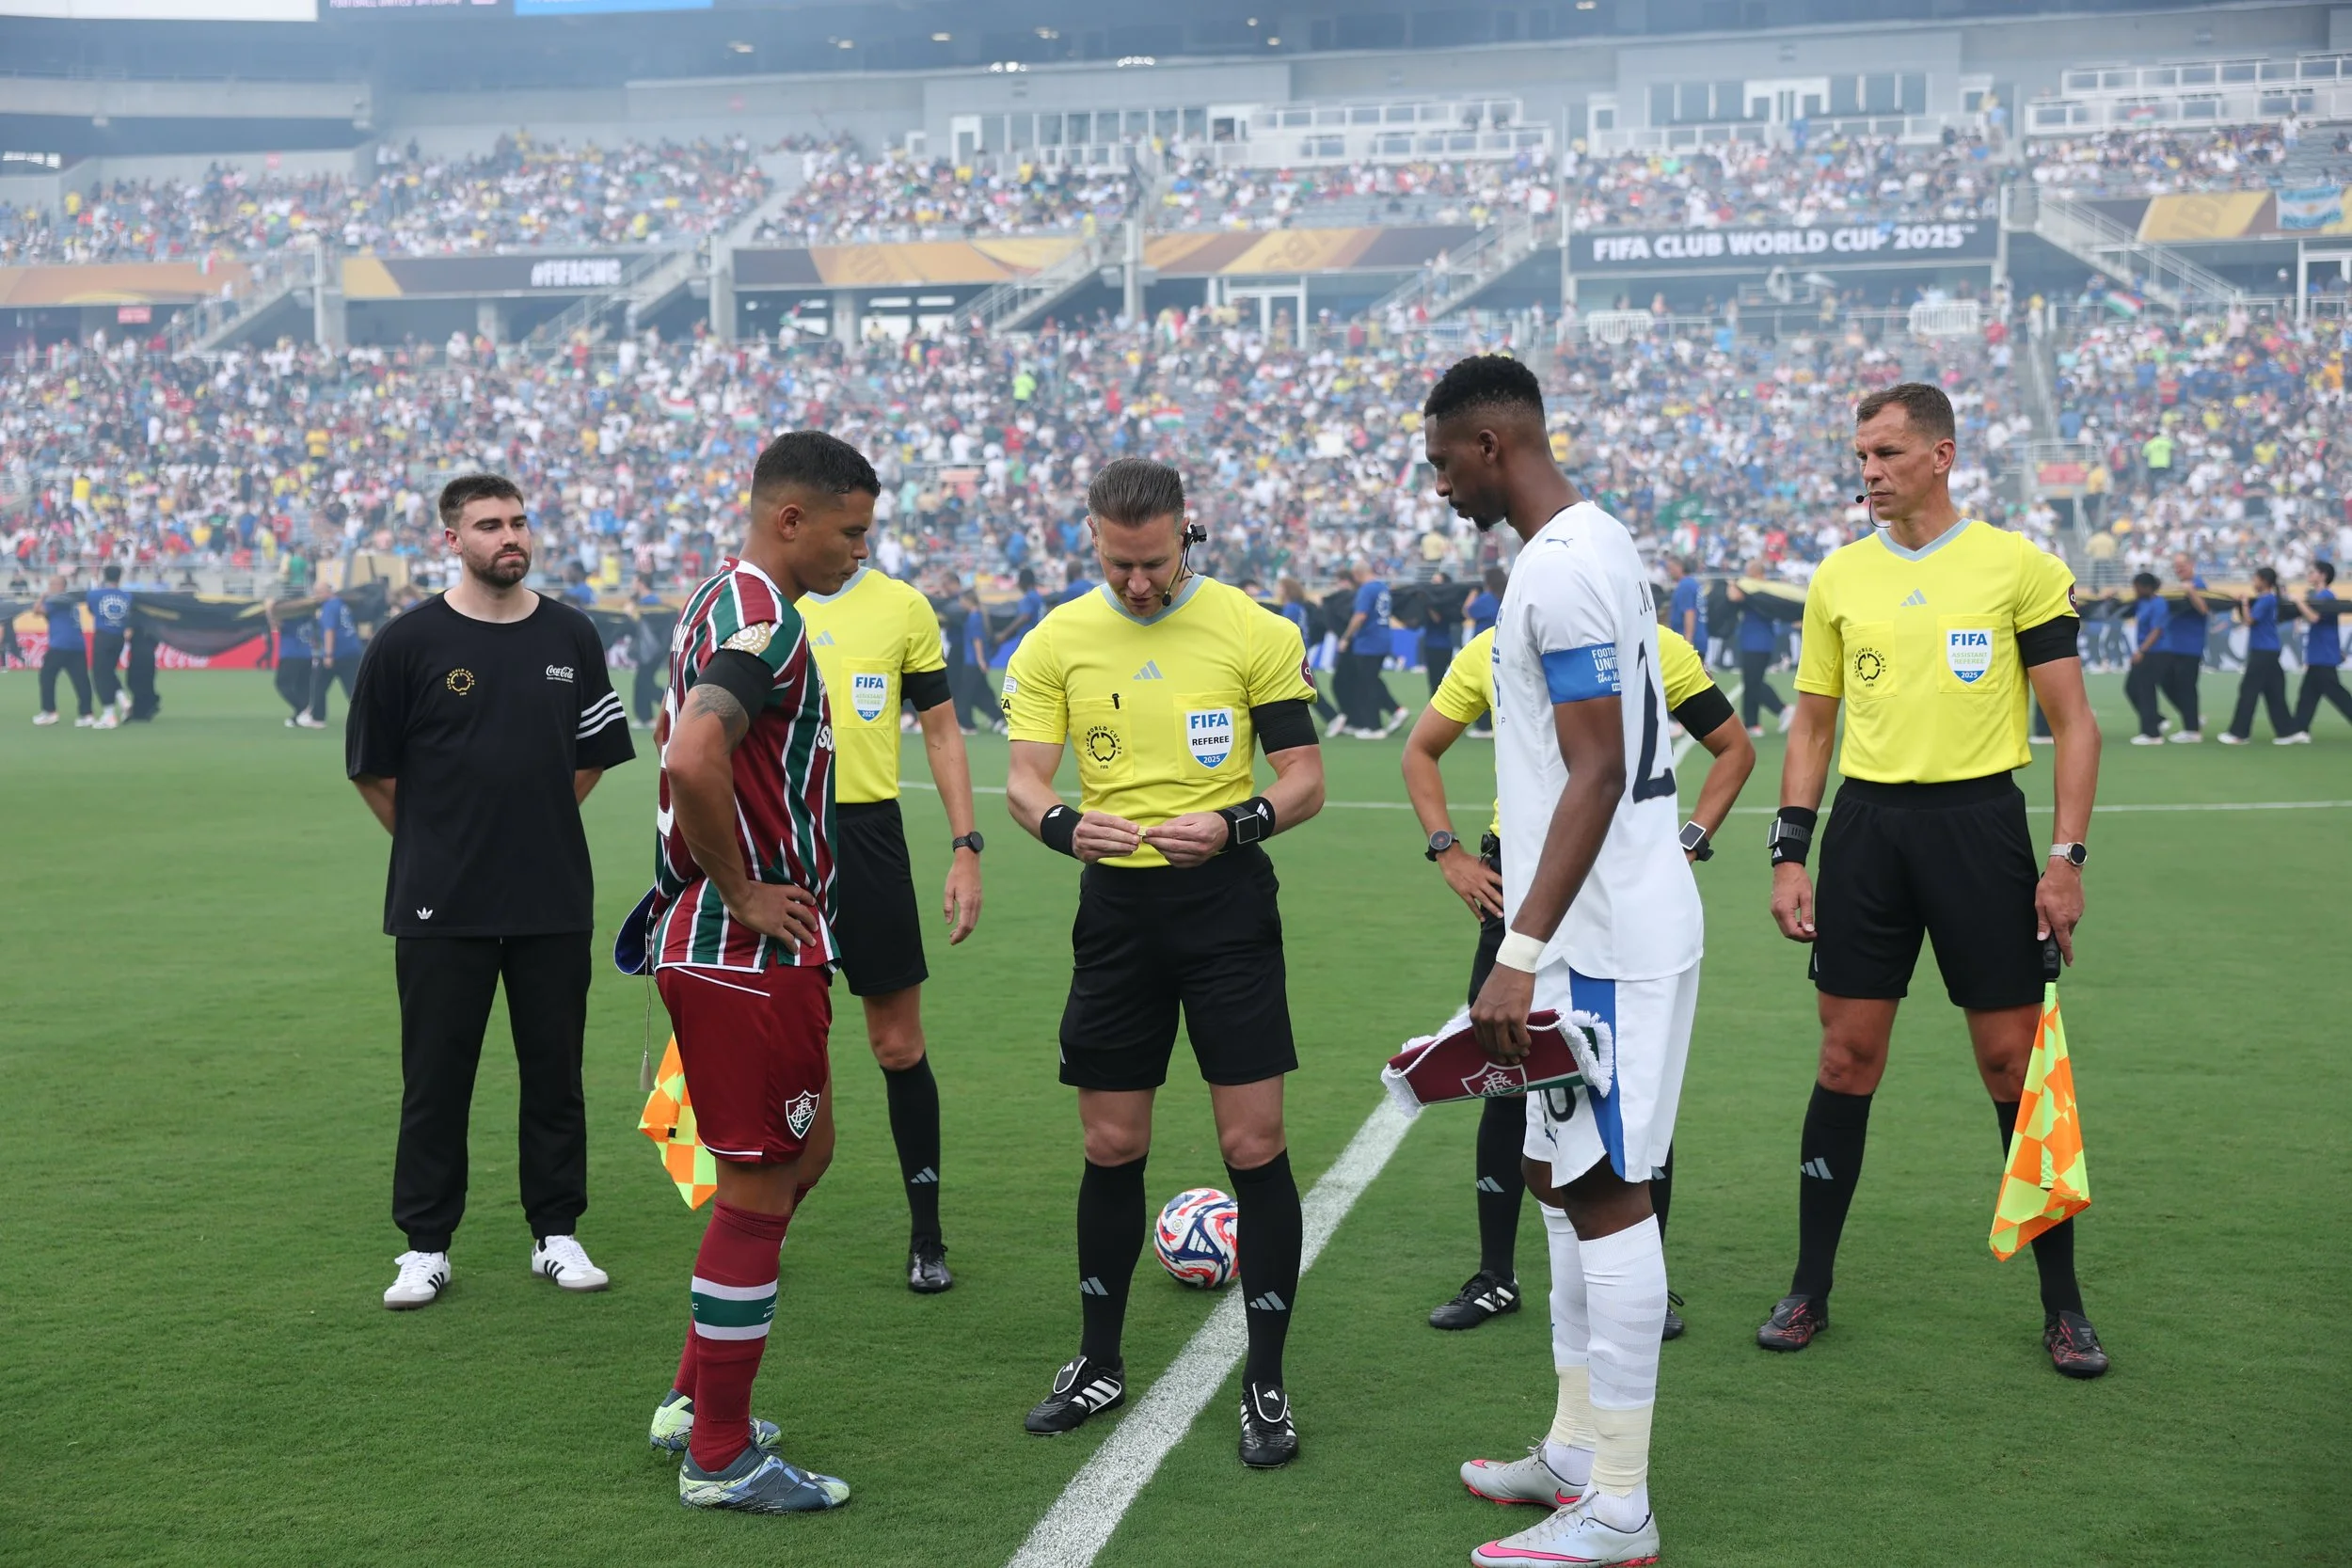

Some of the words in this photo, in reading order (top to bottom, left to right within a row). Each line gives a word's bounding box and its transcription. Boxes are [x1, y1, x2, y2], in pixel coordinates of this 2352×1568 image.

[1593, 235, 1652, 262] FIFA
[1653, 232, 1725, 260] CLUB
[1728, 230, 1828, 256] WORLD
[1831, 226, 1891, 254] CUP
[1893, 224, 1964, 250] 2025
[1951, 633, 1988, 646] FIFA
[546, 664, 574, 679] Coca-Cola
[855, 676, 884, 689] FIFA
[1190, 712, 1229, 730] FIFA
[1088, 726, 1107, 736] WORLD
[1110, 730, 1120, 743] CUP
[1192, 735, 1230, 746] REFEREE
[1203, 755, 1221, 764] 2025
